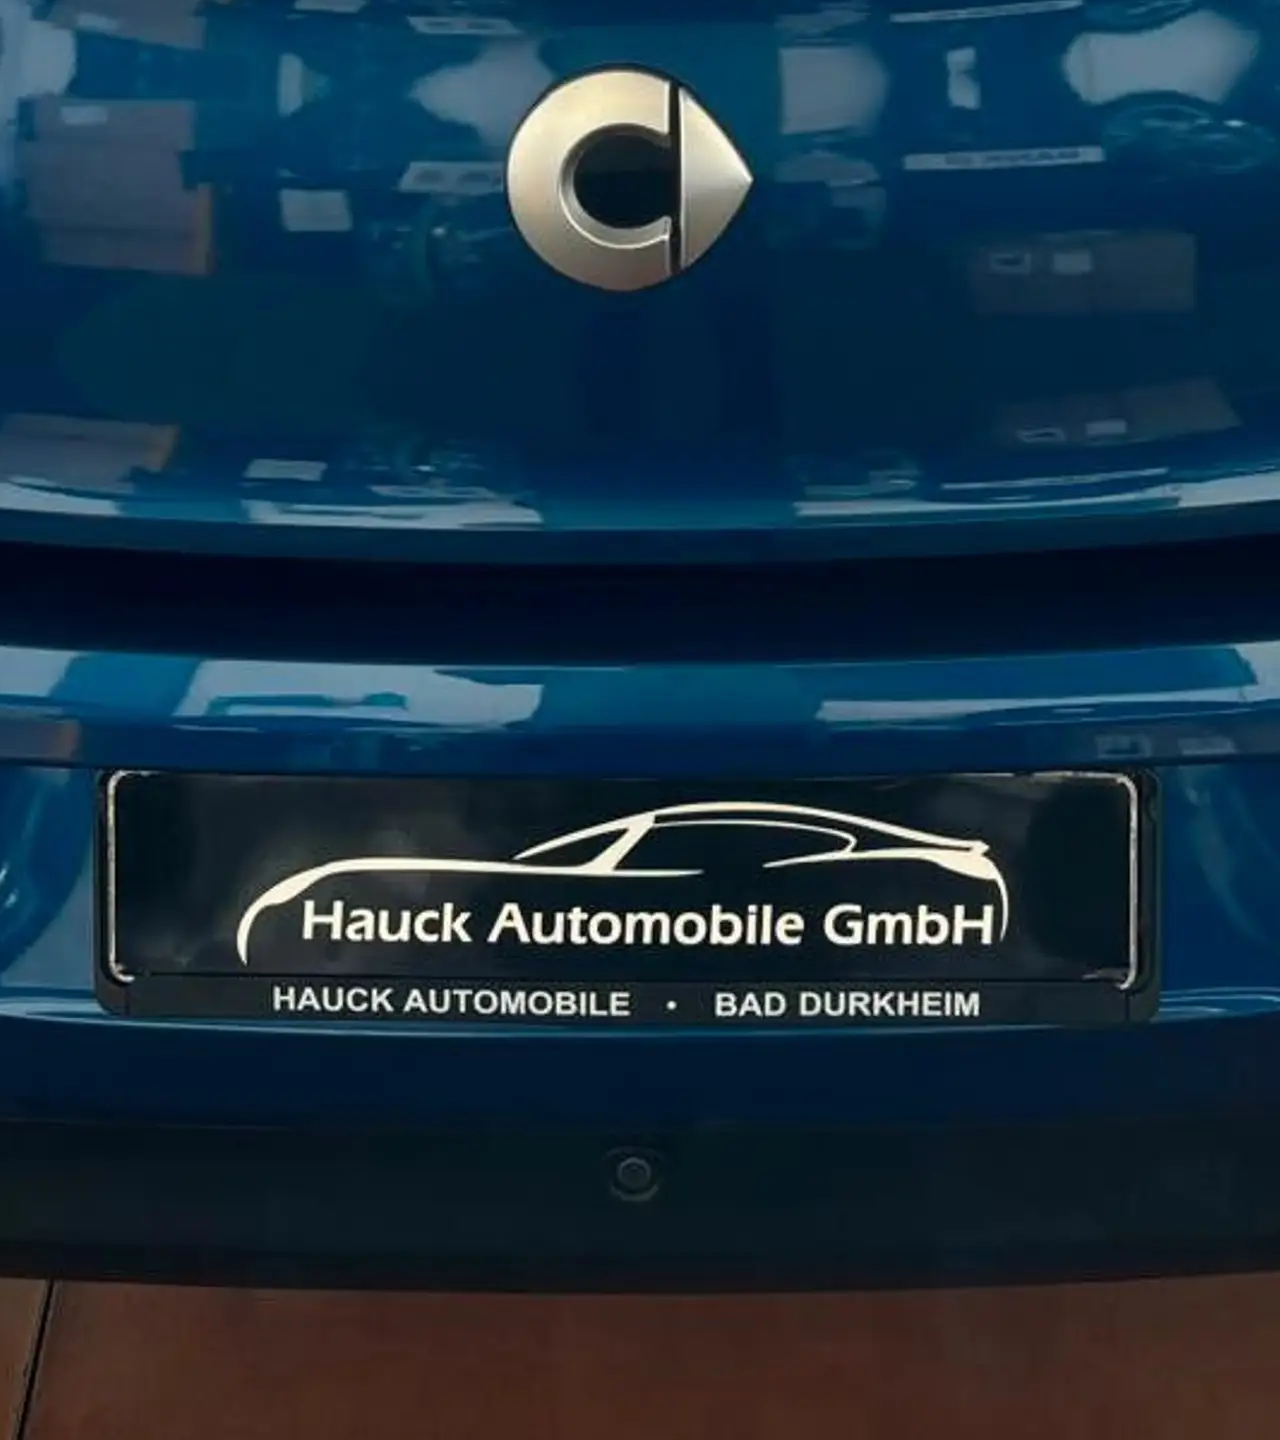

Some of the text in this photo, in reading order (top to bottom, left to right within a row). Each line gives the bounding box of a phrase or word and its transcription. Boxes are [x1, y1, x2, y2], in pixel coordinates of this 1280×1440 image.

[302, 900, 994, 946] Hauck Automobile GmbH
[273, 986, 981, 1017] HAUCK AUTOMOBILE BAD DURKHEIM
